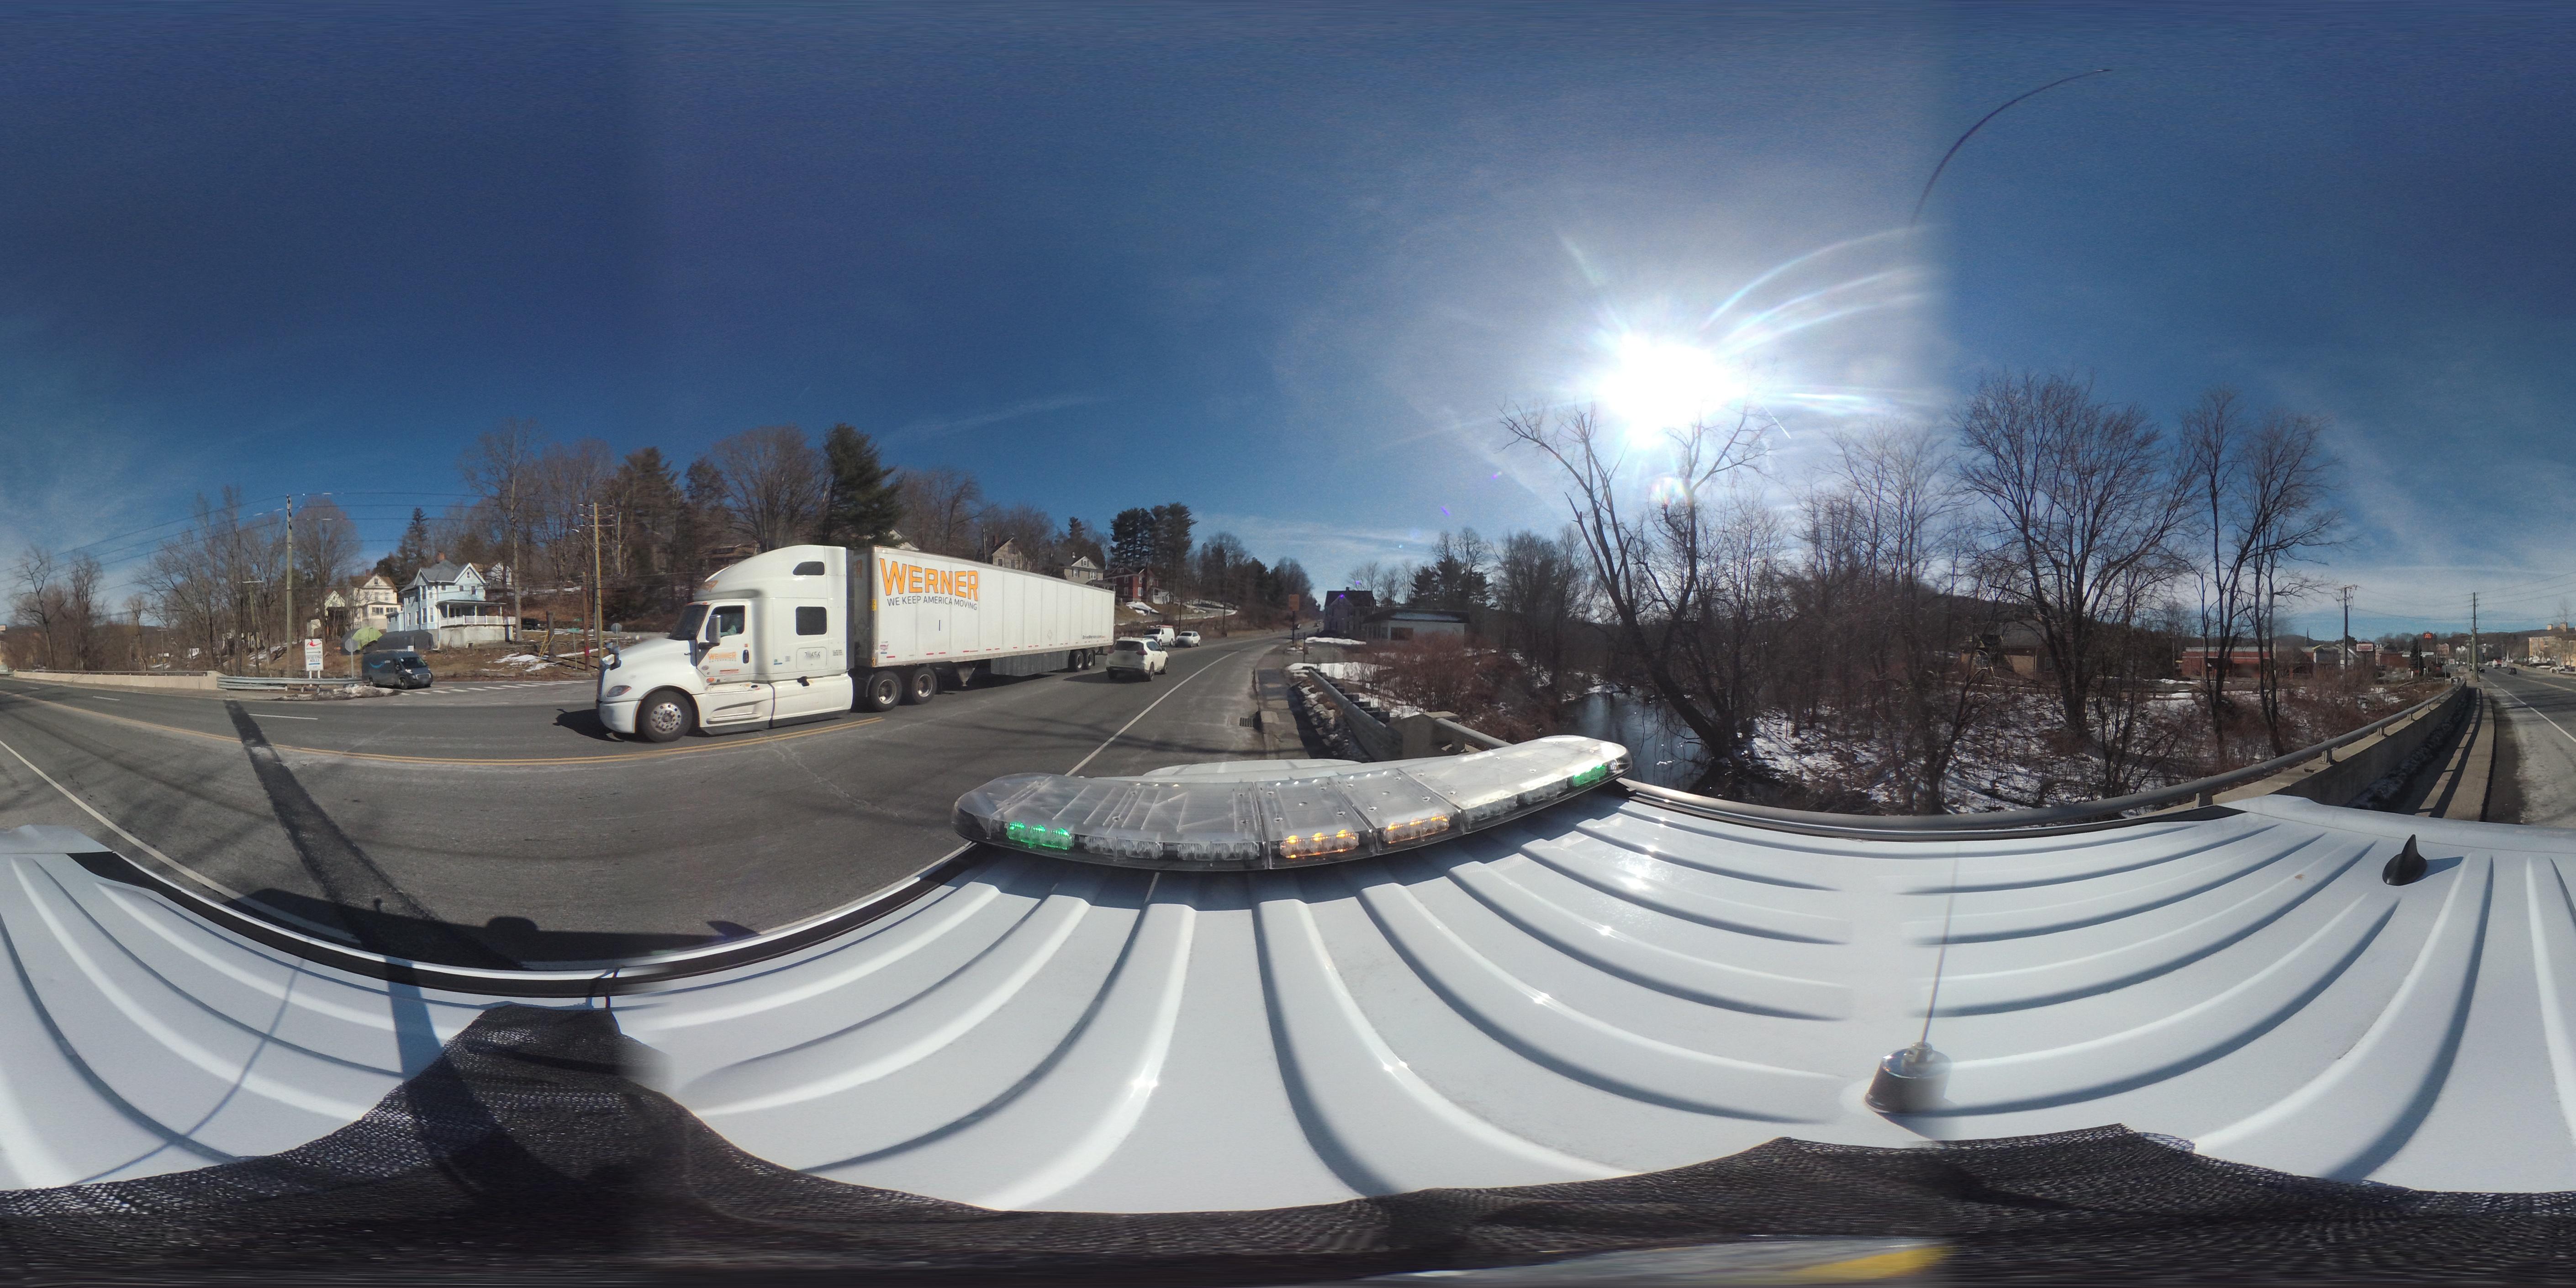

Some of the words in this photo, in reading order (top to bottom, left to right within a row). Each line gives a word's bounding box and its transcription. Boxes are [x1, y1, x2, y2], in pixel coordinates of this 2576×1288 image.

[879, 558, 978, 601] WERNER
[887, 597, 900, 607] WE
[903, 596, 921, 604] KEEP
[923, 596, 953, 605] AMERICA
[954, 599, 977, 610] MOVING
